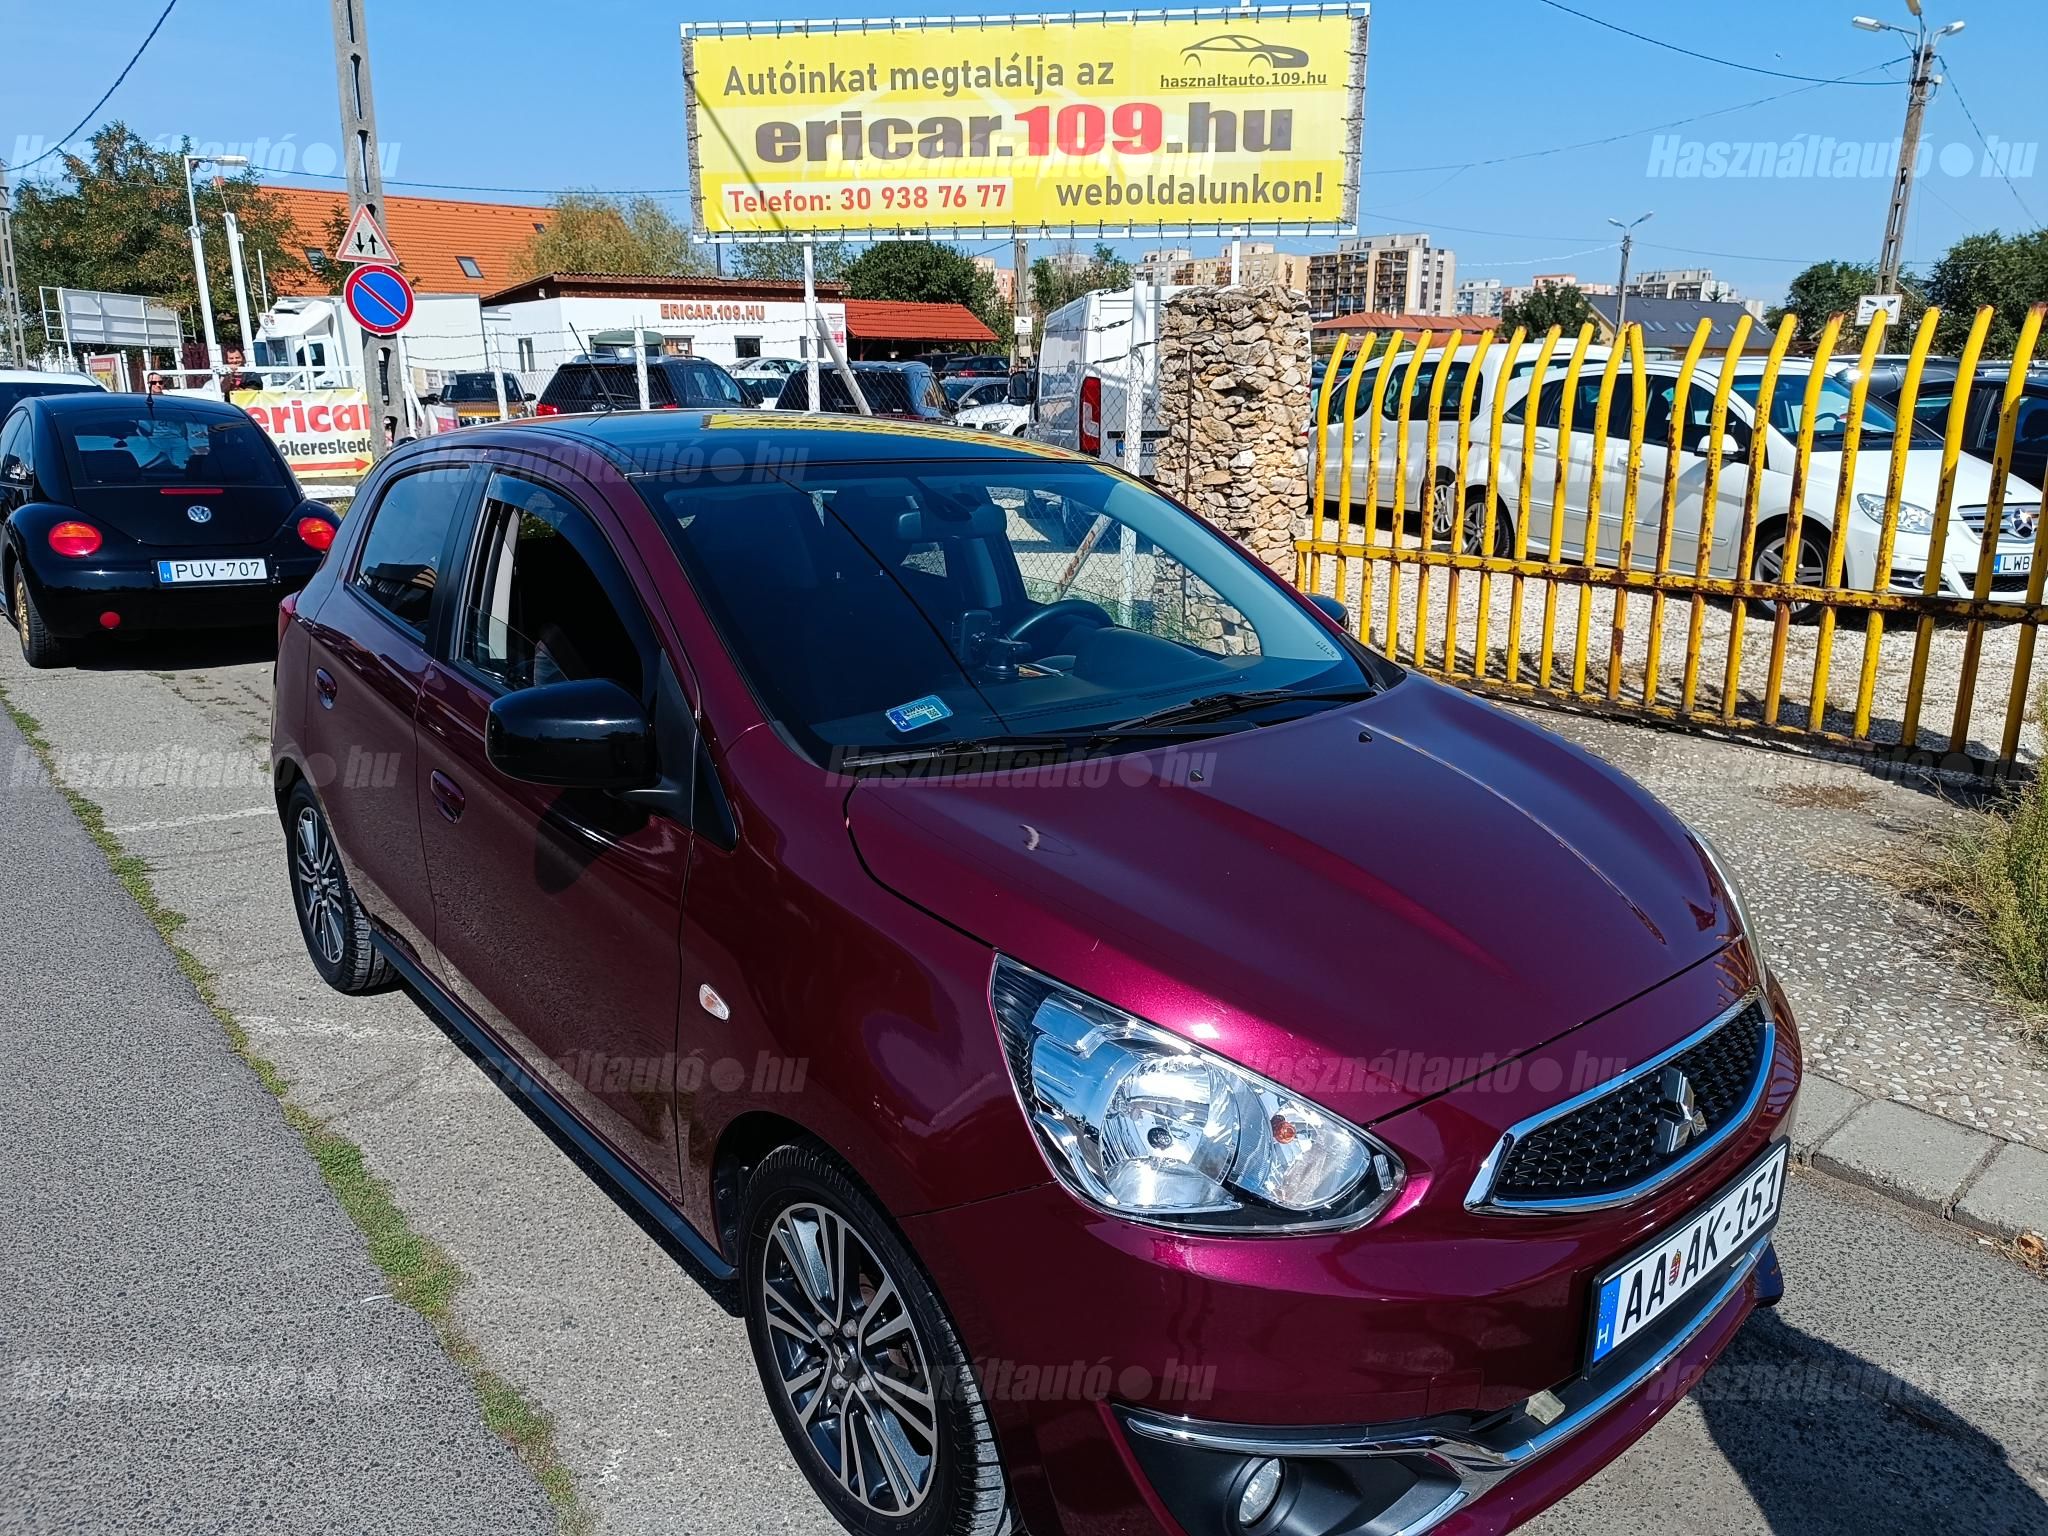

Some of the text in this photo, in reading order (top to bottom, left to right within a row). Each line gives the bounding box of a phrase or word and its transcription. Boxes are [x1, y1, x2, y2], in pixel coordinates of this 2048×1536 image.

[724, 52, 1114, 97] Autóinkat megtalálja az
[1160, 71, 1327, 88] hasznaltauto.109.hu
[755, 101, 1293, 163] ericar.109.hu
[728, 184, 1006, 213] Telefon: 30 938 76 77
[1056, 172, 1322, 207] weboldalunkon!
[660, 303, 765, 321] ERICAR.109.HU
[175, 561, 260, 579] PUV-707
